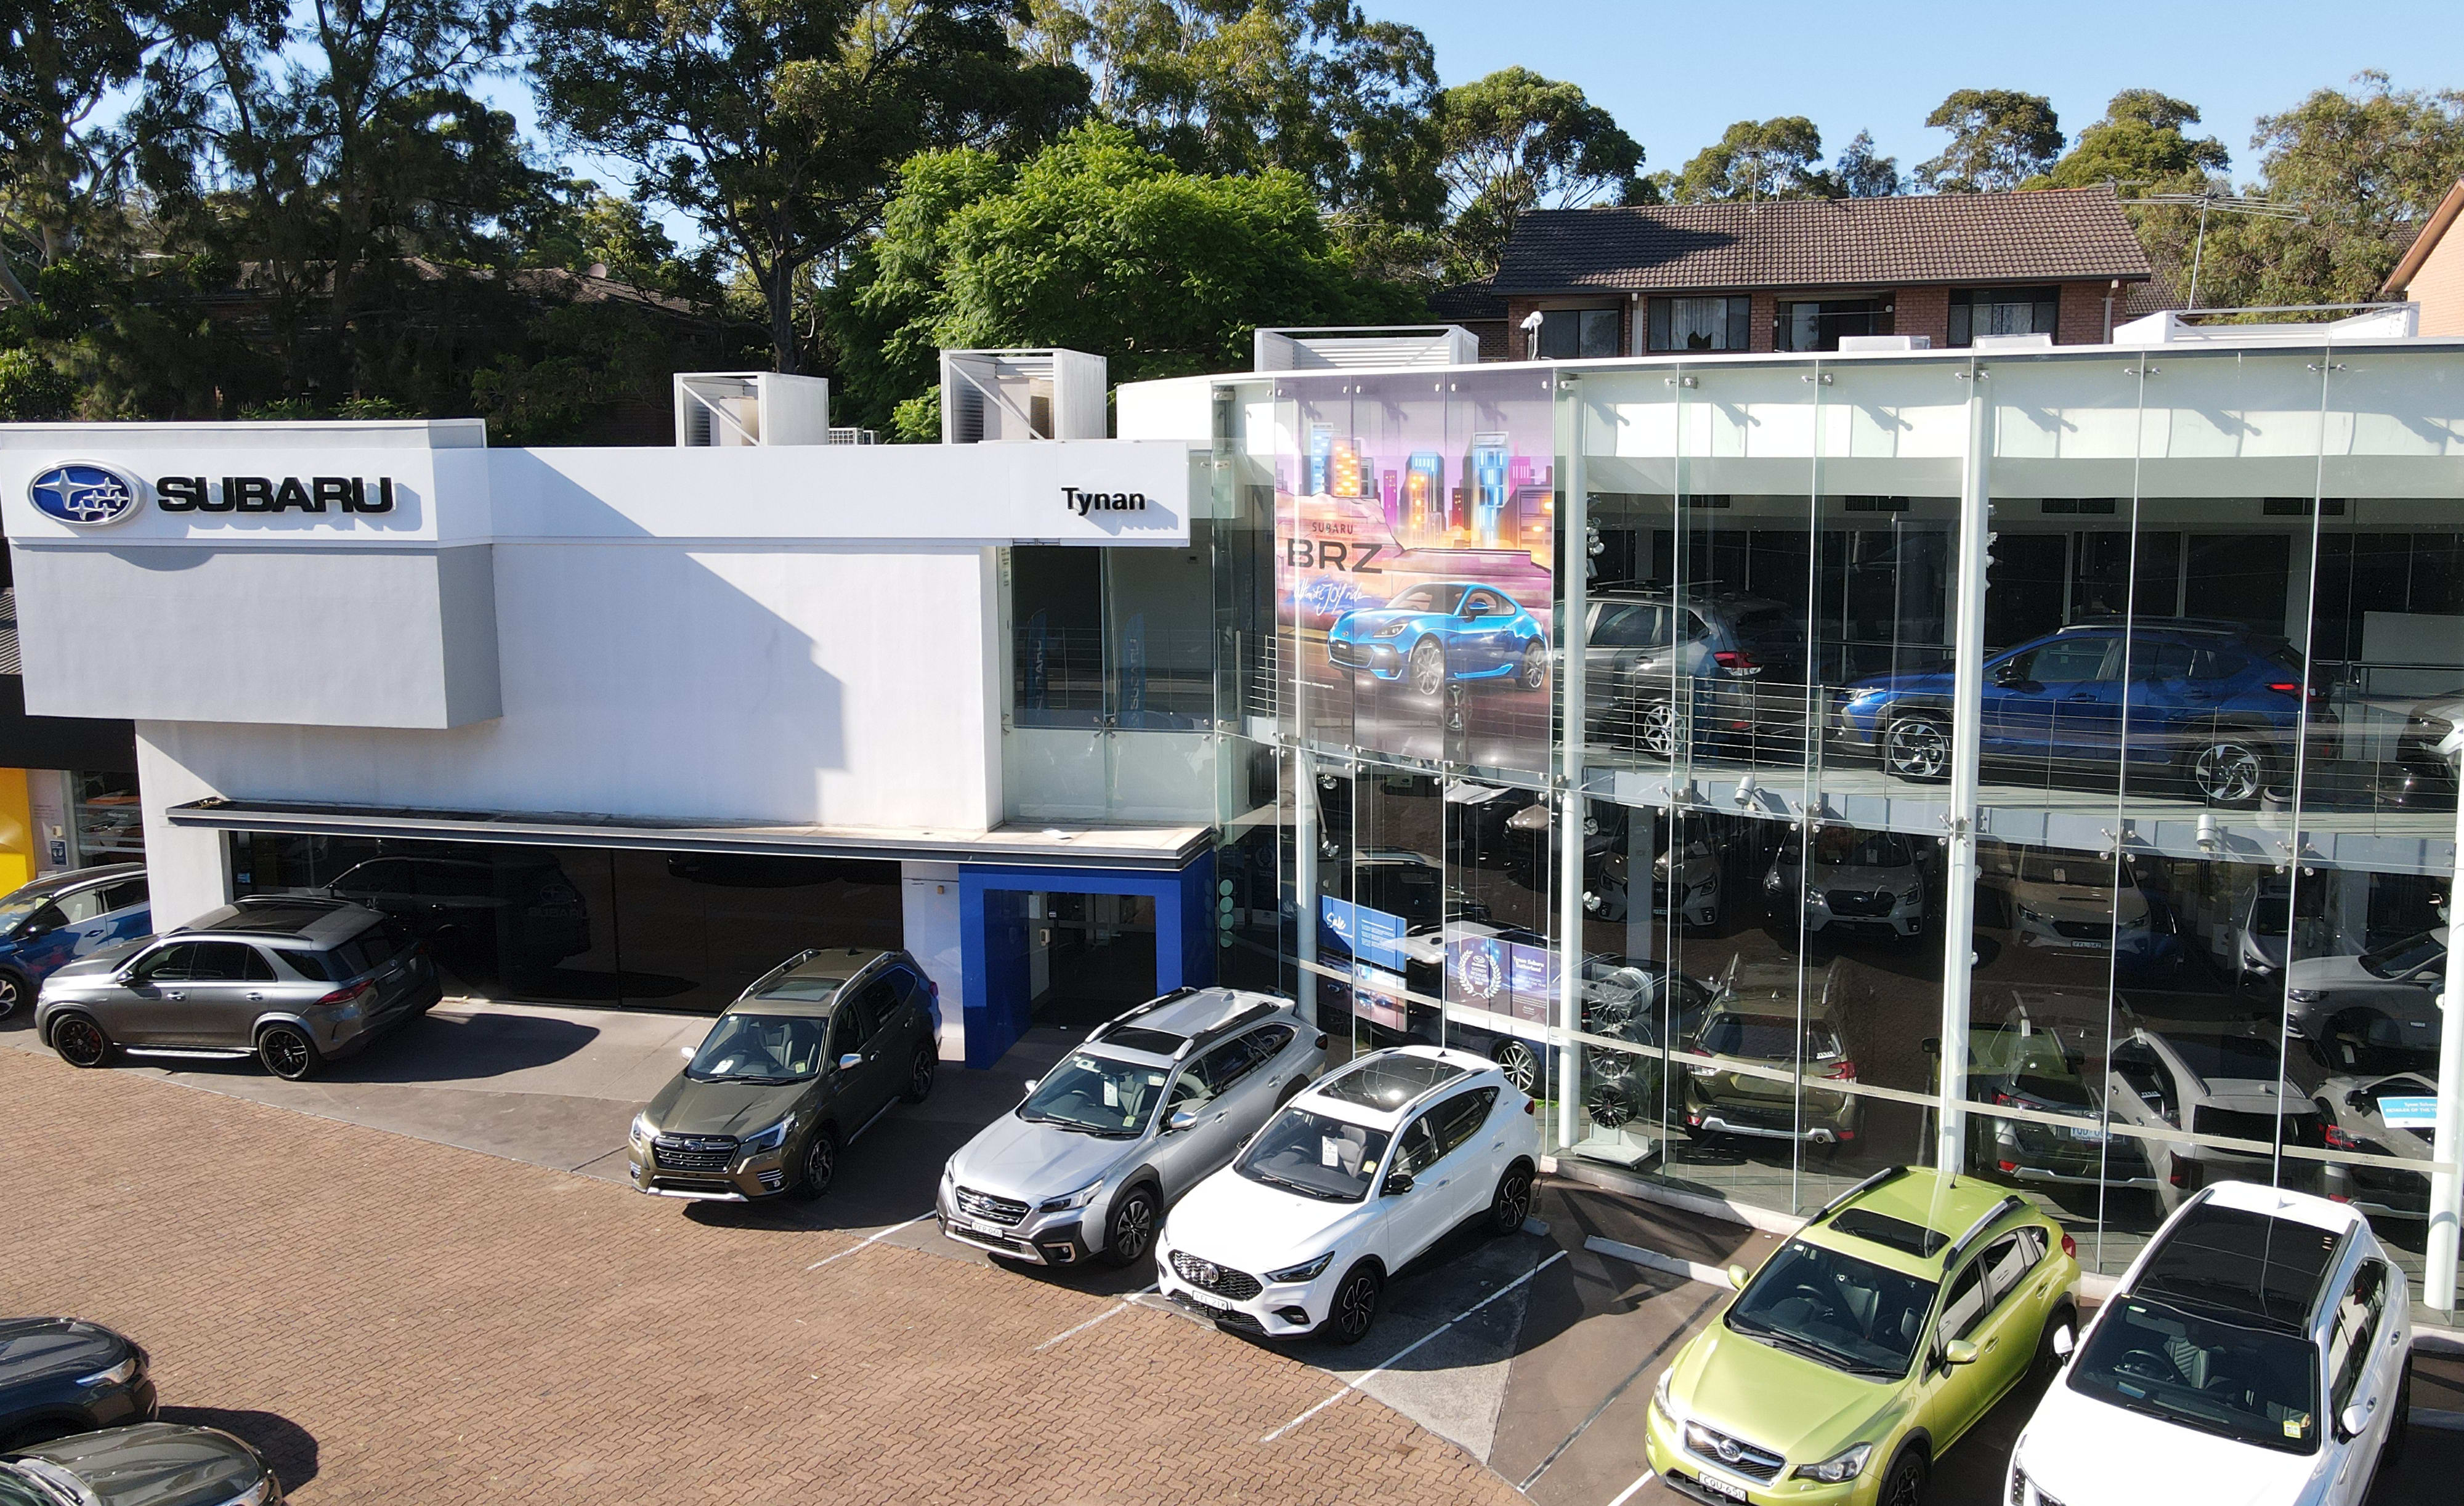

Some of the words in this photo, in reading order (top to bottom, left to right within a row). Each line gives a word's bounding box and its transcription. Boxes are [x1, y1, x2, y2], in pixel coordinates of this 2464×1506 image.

[156, 476, 394, 513] SUBARU
[1061, 487, 1145, 516] Tynan
[1312, 522, 1353, 534] SUBARU
[1287, 538, 1382, 574] BRZ
[1326, 912, 1346, 929] Sale
